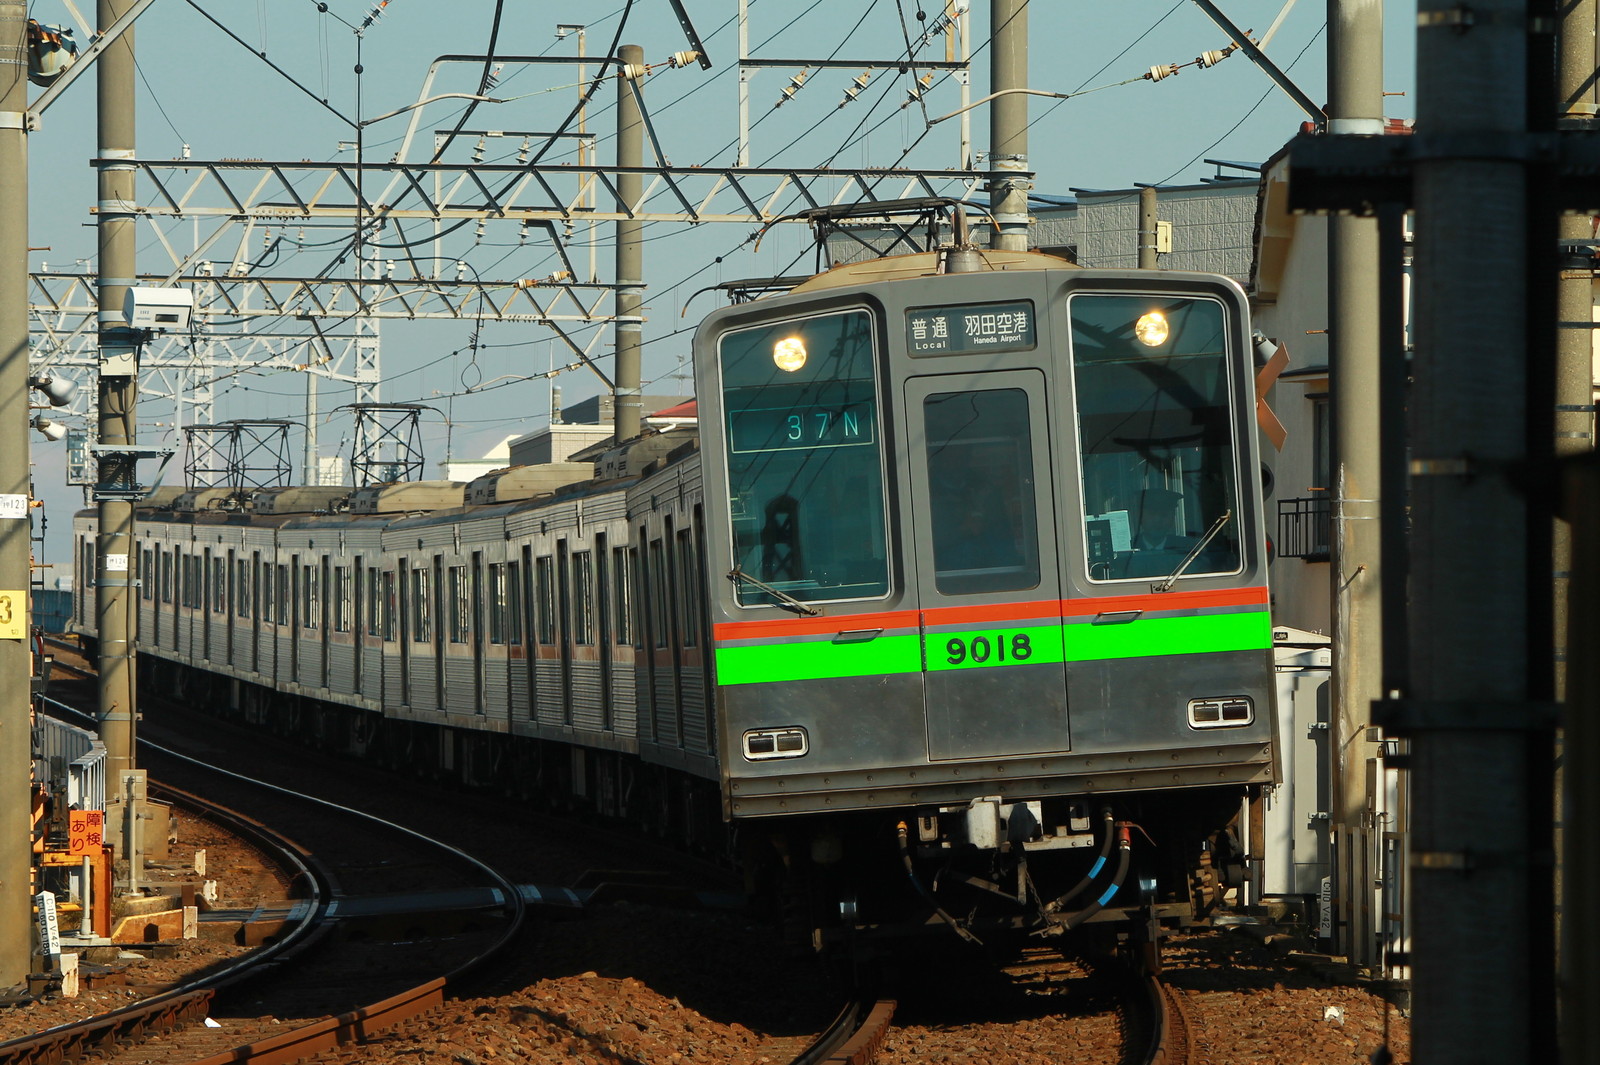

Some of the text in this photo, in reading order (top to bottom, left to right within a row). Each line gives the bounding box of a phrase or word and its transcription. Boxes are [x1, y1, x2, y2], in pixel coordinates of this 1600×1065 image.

[912, 316, 948, 340] 普通
[965, 311, 1028, 336] 羽田空港
[915, 341, 946, 350] Local
[973, 334, 1022, 344] Haneda Airport
[946, 633, 1032, 665] 9018
[72, 820, 85, 851] あり
[86, 813, 101, 846] 障検
